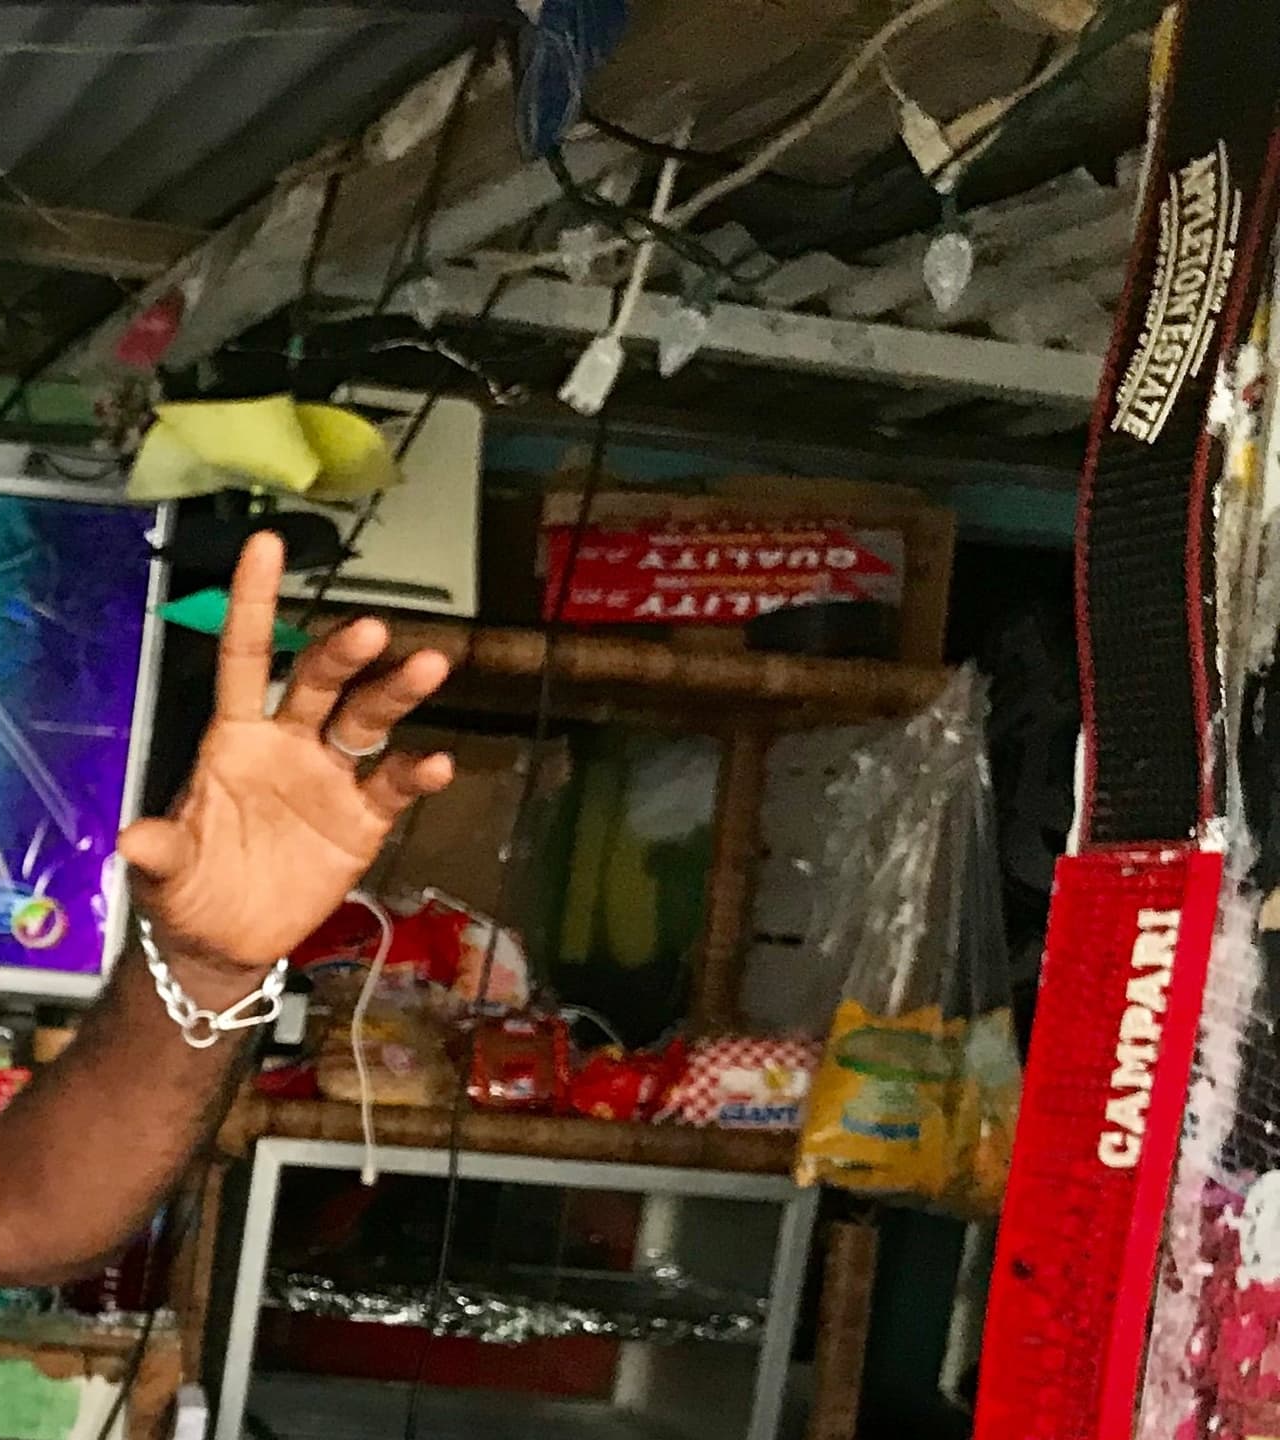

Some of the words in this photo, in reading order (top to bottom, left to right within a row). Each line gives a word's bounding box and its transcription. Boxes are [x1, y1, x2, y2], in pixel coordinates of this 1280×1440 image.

[1122, 324, 1193, 441] ESTATE
[639, 545, 857, 571] QUALITY
[1097, 908, 1180, 1169] CAMPARI
